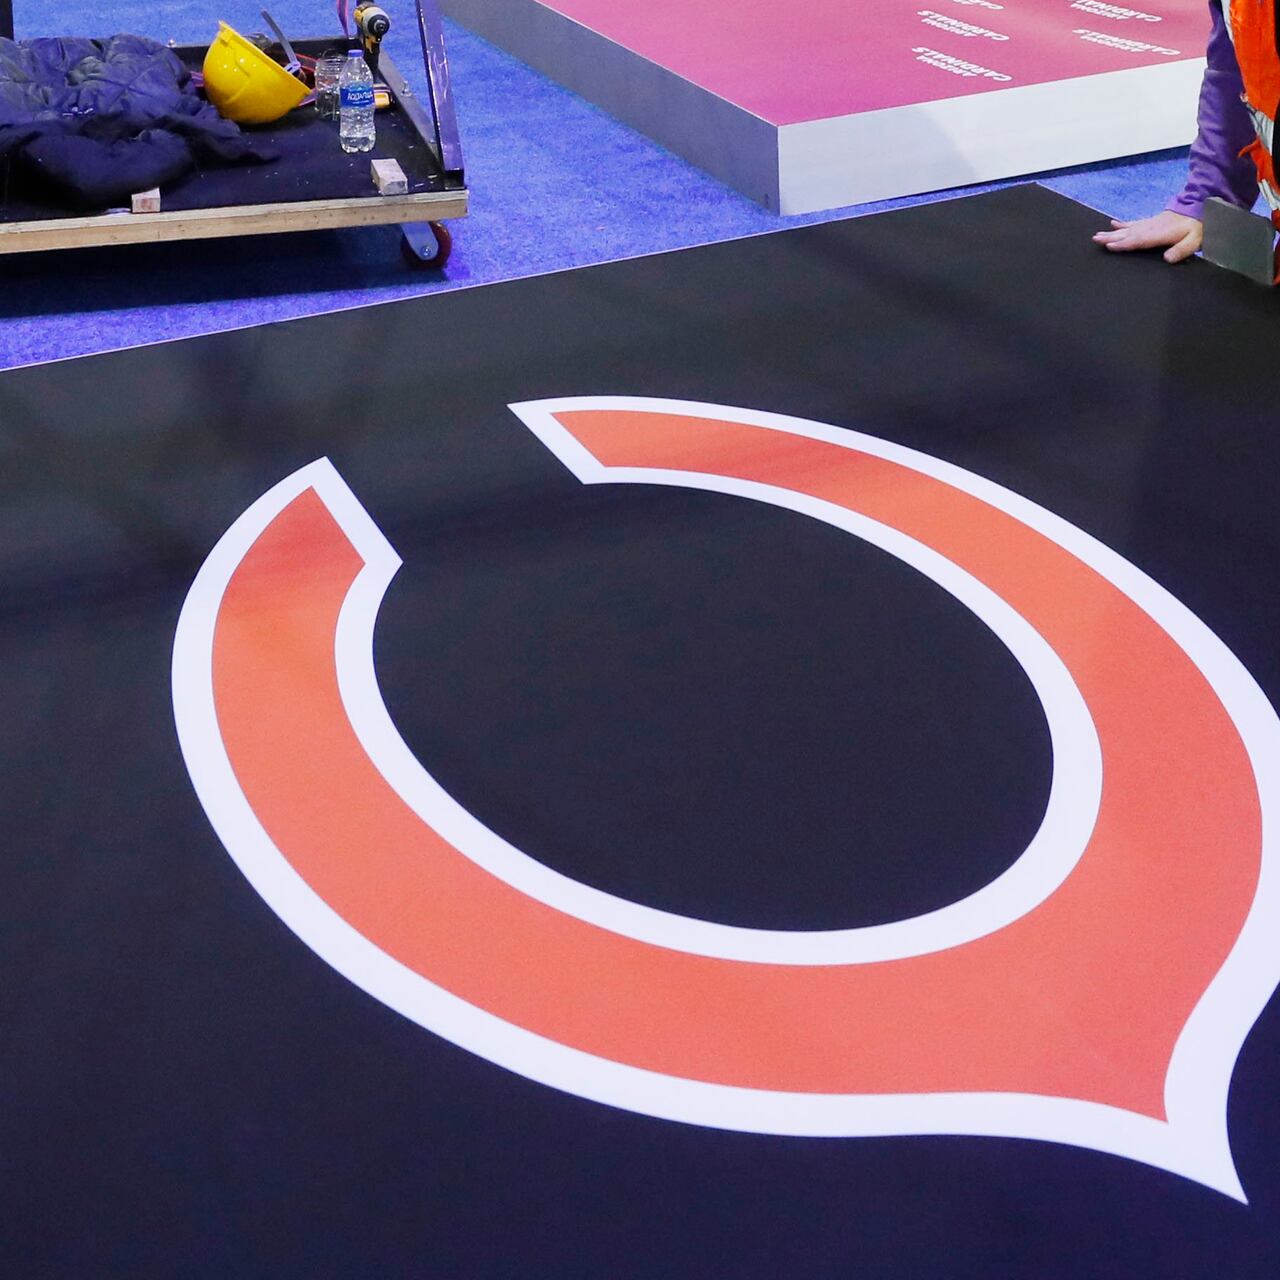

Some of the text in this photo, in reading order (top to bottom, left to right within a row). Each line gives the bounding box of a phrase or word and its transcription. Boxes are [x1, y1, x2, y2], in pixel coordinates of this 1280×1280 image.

[918, 10, 1009, 41] CARDINALS
[1073, 29, 1180, 55] CARDINALS
[912, 47, 1012, 81] CARDINALS
[916, 56, 977, 76] ARIZONA
